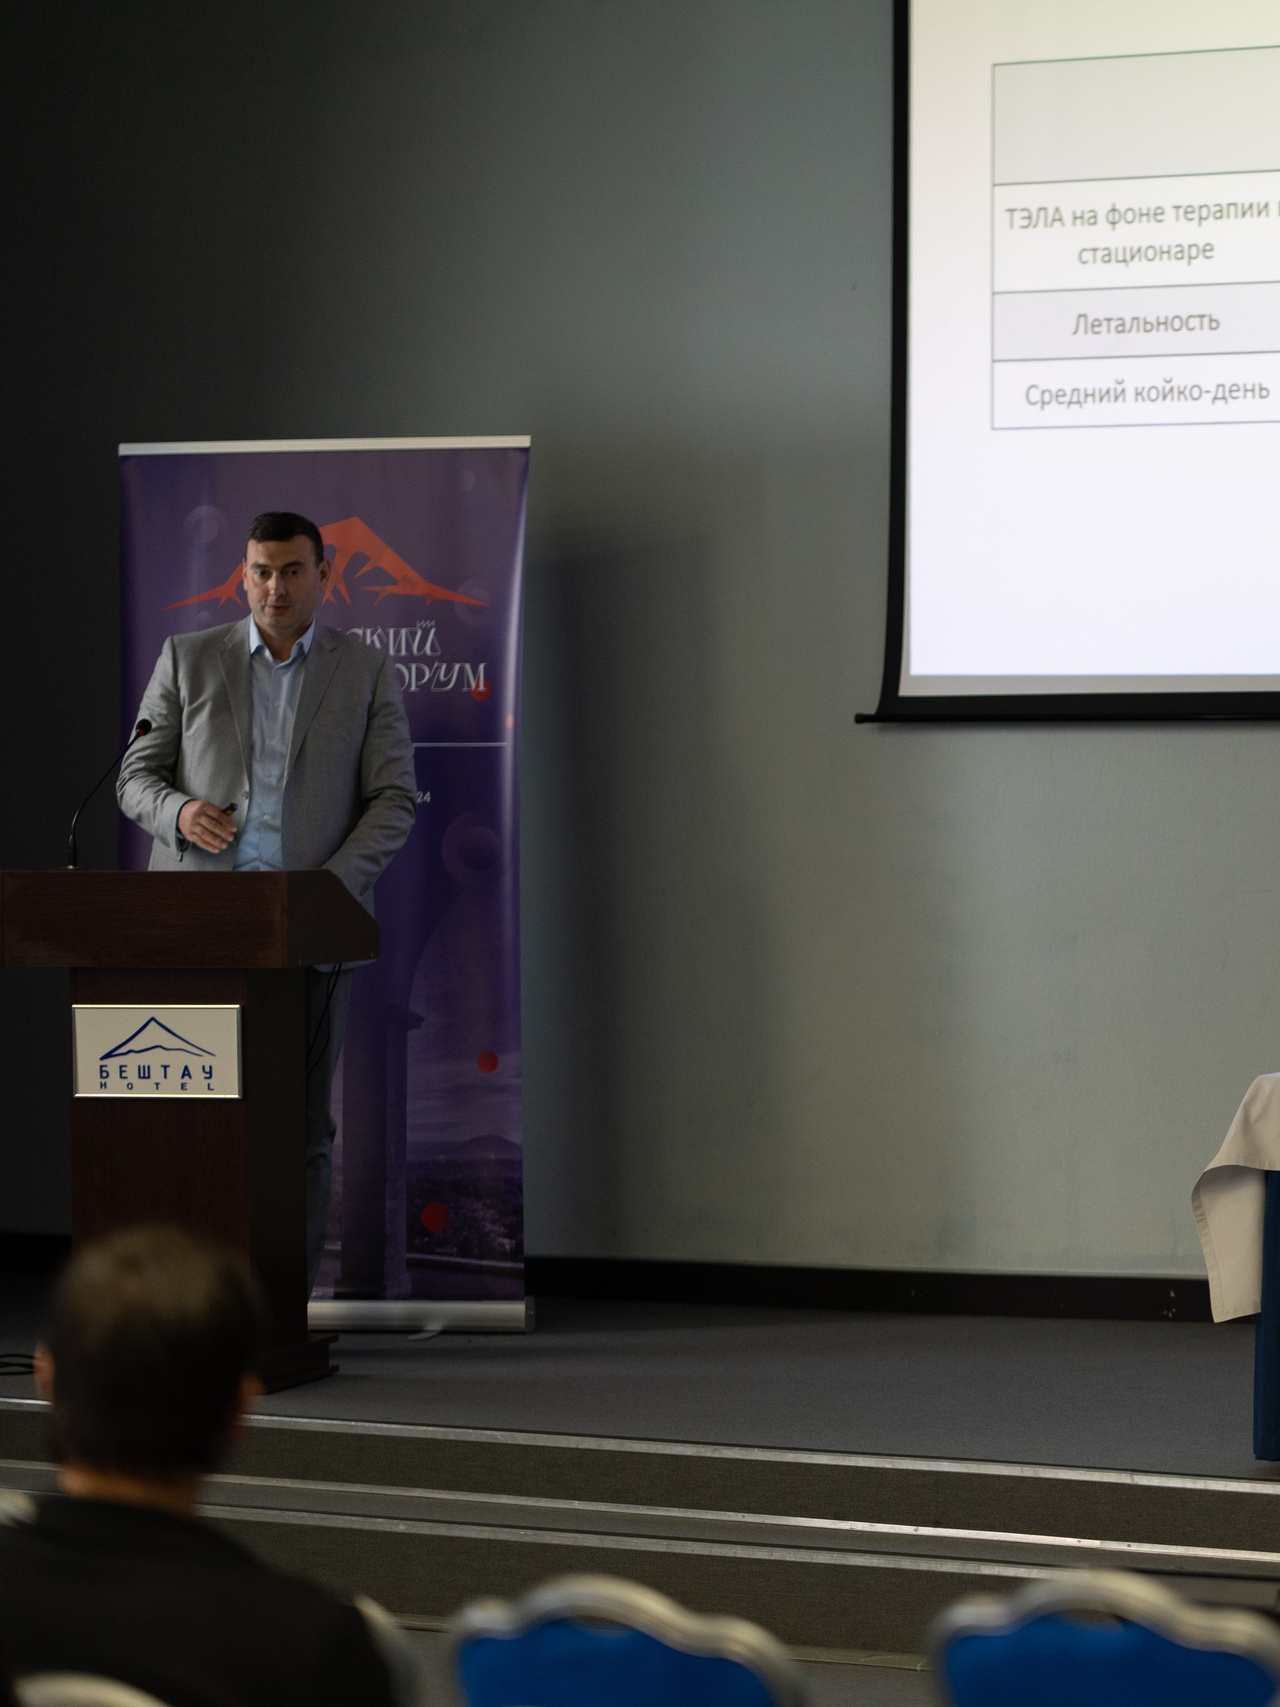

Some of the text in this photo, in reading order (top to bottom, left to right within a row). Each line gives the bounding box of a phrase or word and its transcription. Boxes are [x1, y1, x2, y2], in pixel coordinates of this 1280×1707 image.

[1004, 206, 1066, 230] ТЭЛА
[1071, 209, 1098, 227] на
[1105, 202, 1166, 231] фоне
[1171, 201, 1270, 230] терапии
[1077, 241, 1215, 268] стационаре
[1071, 312, 1221, 337] Летальность
[1025, 377, 1271, 410] Средний койко-день
[416, 790, 431, 804] 24
[99, 1064, 213, 1080] БЕШТАУ
[99, 1081, 215, 1091] HOTEL
